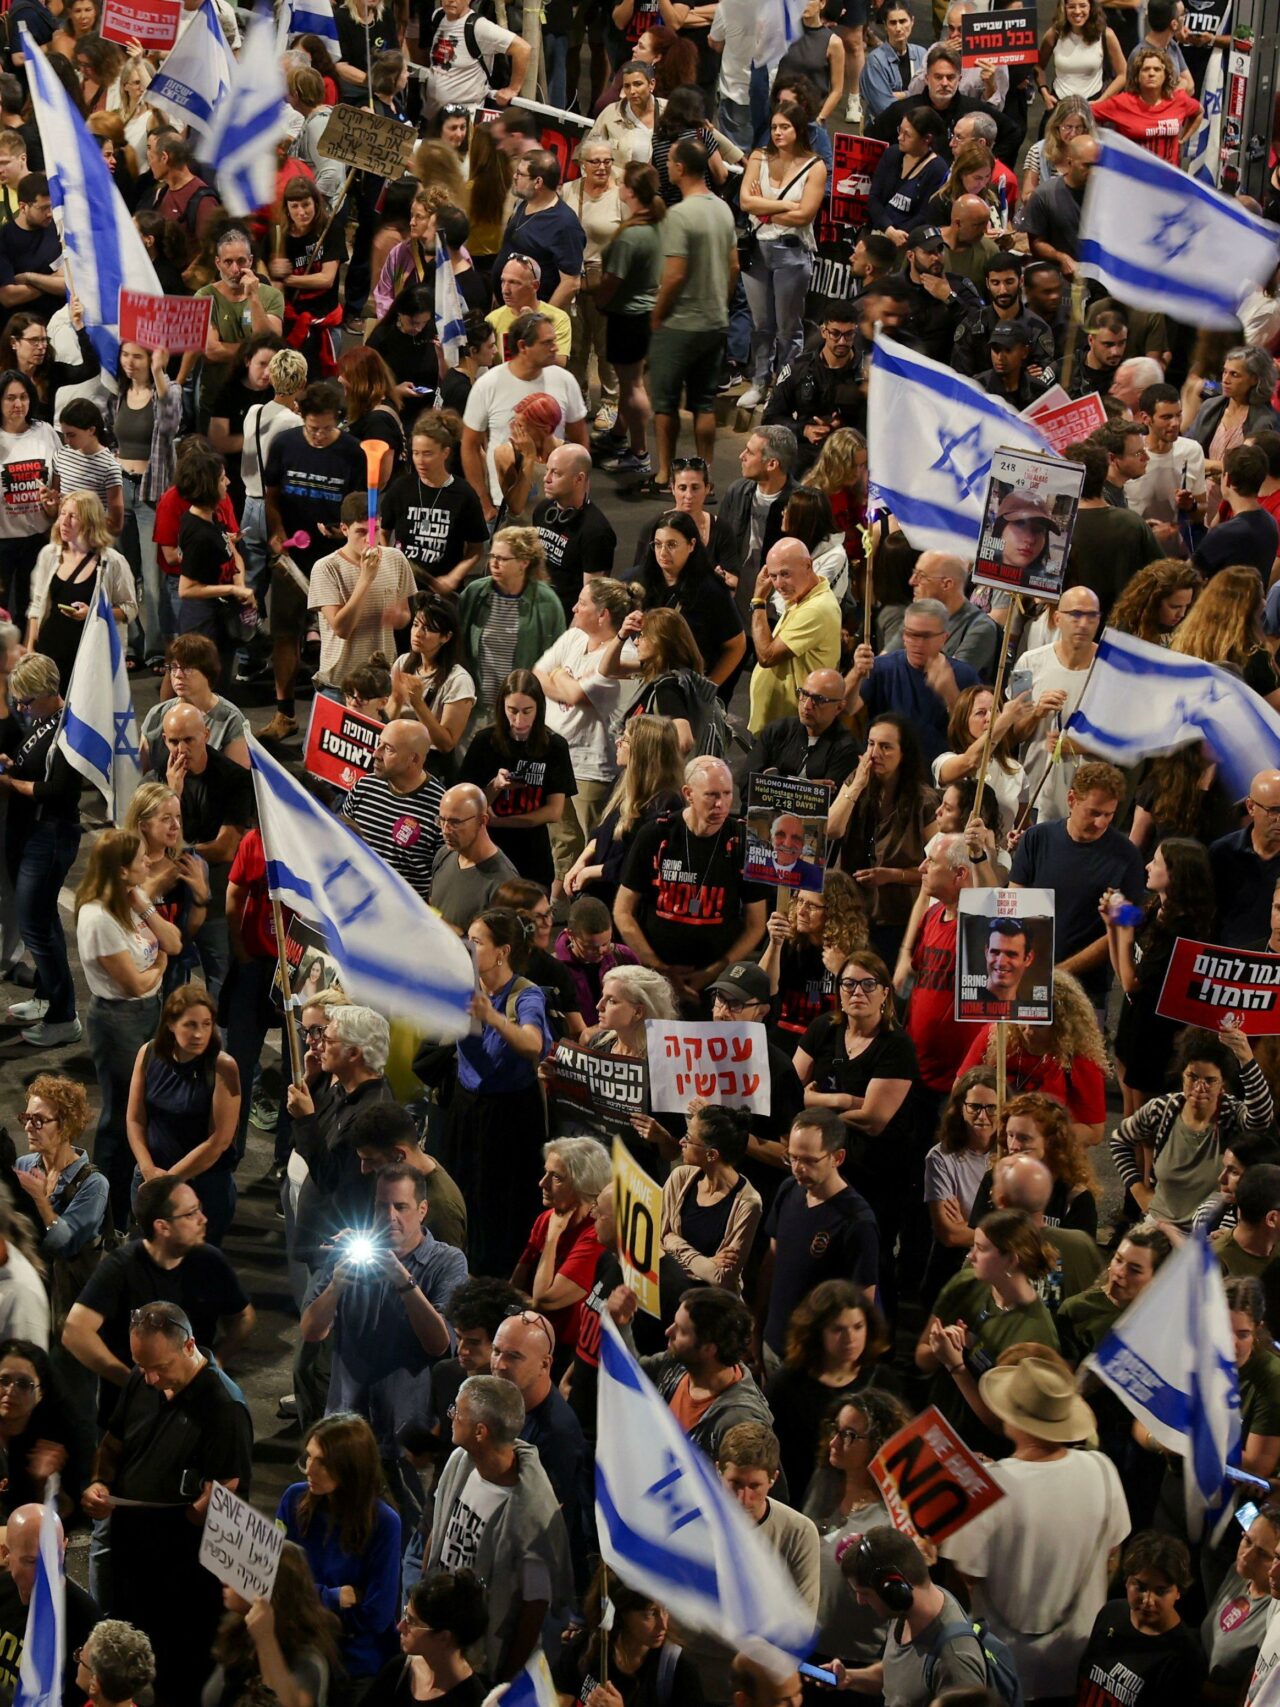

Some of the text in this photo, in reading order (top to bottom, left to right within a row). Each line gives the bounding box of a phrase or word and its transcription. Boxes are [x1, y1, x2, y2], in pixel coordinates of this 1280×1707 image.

[1182, 12, 1220, 31] בחירו
[966, 30, 1034, 50] בכל מחיר
[8, 462, 42, 473] BRING
[1000, 461, 1017, 472] 218
[407, 506, 450, 525] בחירות
[982, 533, 1007, 550] BRING
[979, 547, 995, 561] HER
[343, 719, 374, 747] תרופה
[322, 729, 375, 769] לאונס!
[755, 777, 826, 797] SHLOMO MANTZUR 86
[775, 799, 793, 809] 218
[795, 800, 817, 811] DAYS!
[749, 846, 778, 860] BRING
[749, 854, 767, 866] HIM
[661, 858, 682, 873] BRING
[678, 872, 698, 885] HOME
[1192, 954, 1247, 983] להום
[961, 974, 987, 988] BRING
[961, 988, 978, 1000] HIM
[1199, 977, 1273, 1010] הזמן!
[663, 1035, 753, 1072] עסקה
[575, 1051, 643, 1084] הפסקת
[588, 1076, 644, 1105] עכשיו
[675, 1069, 762, 1098] עכשיו
[923, 1423, 992, 1500] WE HAVE
[887, 1435, 968, 1539] NO
[211, 1486, 285, 1558] SAVE RAFAH
[237, 1563, 271, 1598] עסקה
